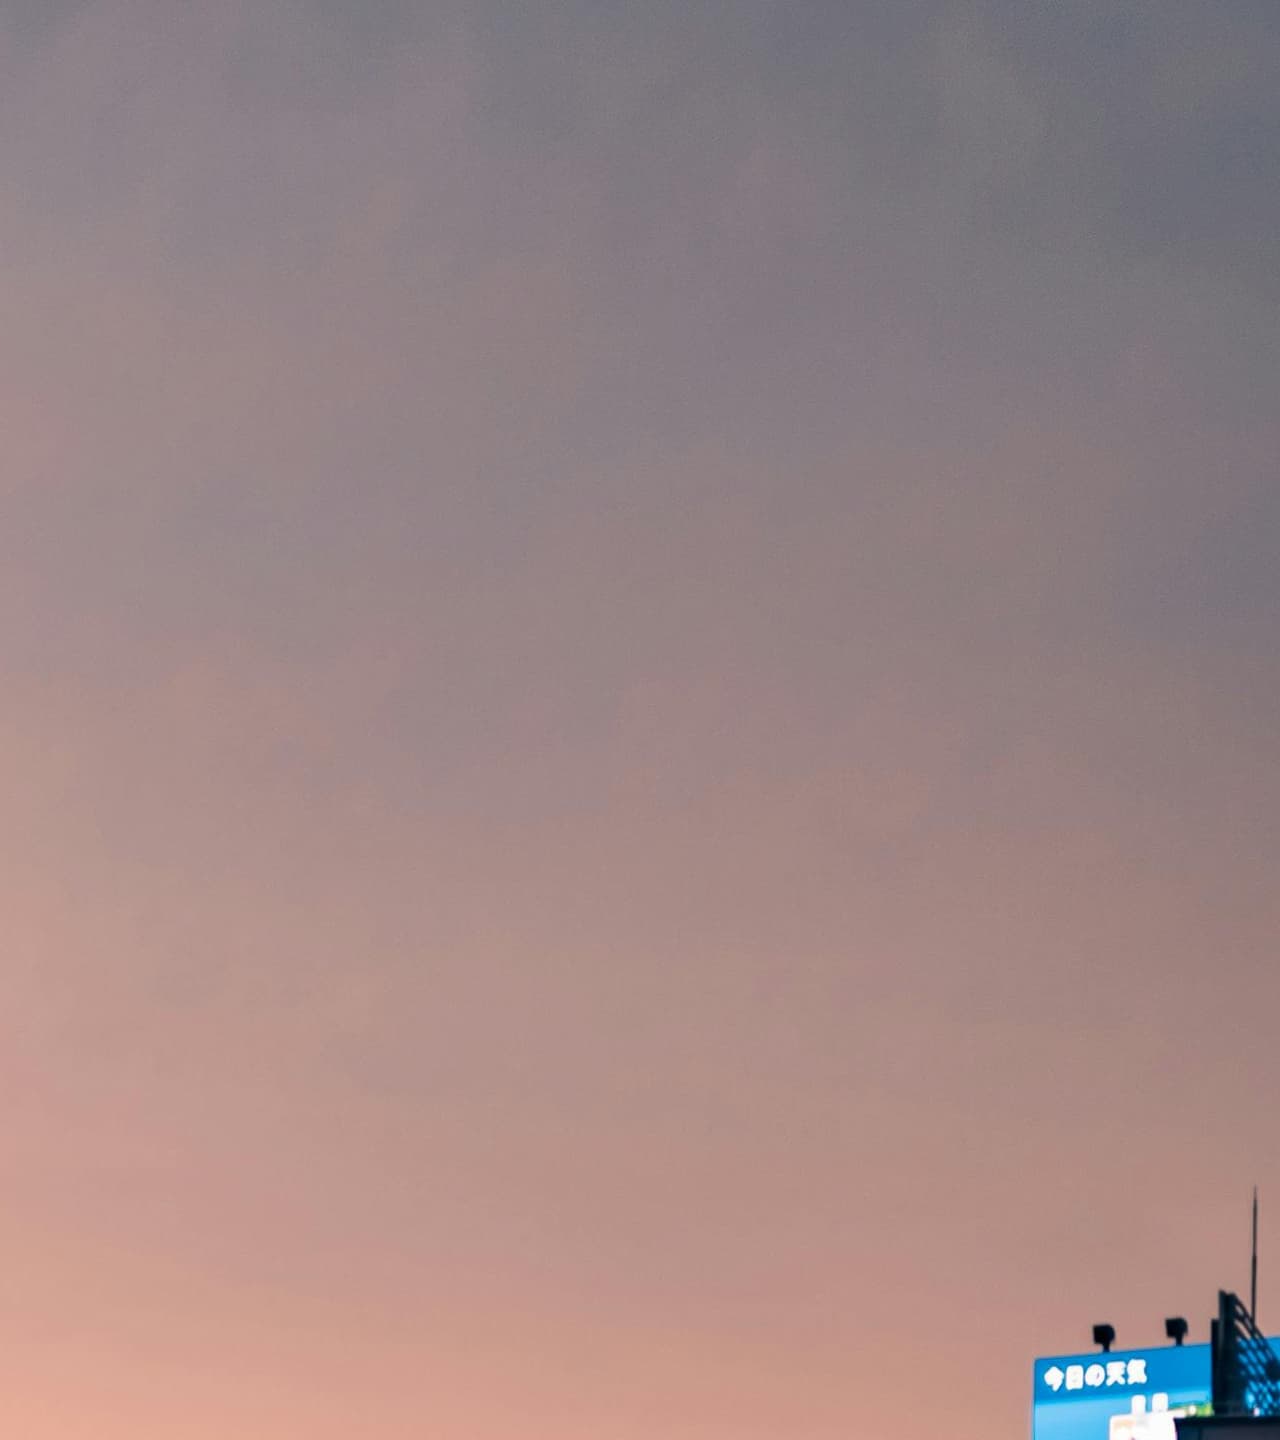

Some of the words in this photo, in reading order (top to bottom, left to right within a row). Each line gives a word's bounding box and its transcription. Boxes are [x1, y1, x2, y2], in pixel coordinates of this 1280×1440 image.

[1044, 1359, 1148, 1391] 今日の天気
